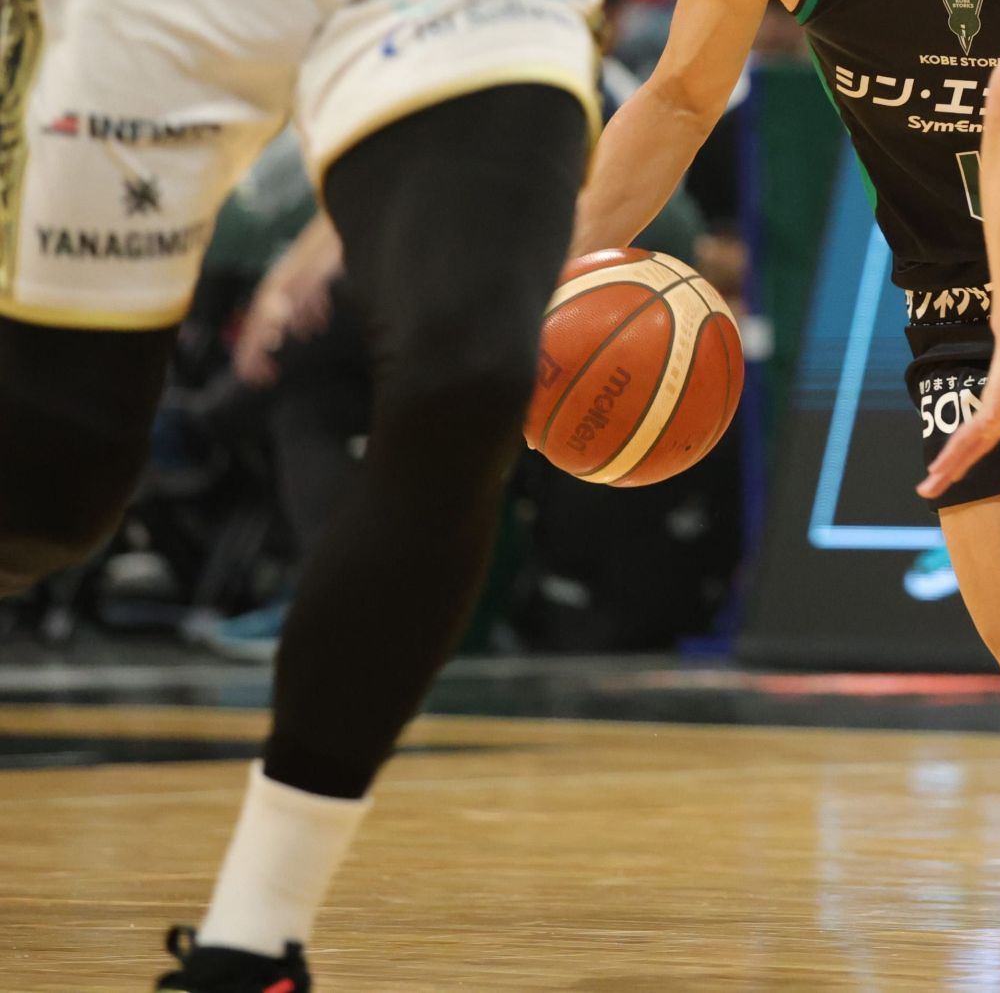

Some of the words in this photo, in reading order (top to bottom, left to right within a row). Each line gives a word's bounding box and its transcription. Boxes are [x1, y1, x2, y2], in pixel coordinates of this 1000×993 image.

[919, 54, 958, 66] KOBE
[960, 57, 1000, 68] STOR
[835, 65, 990, 116] シン・エ
[907, 115, 984, 133] SymEn
[36, 222, 203, 260] YANAGIM
[565, 366, 632, 453] molten
